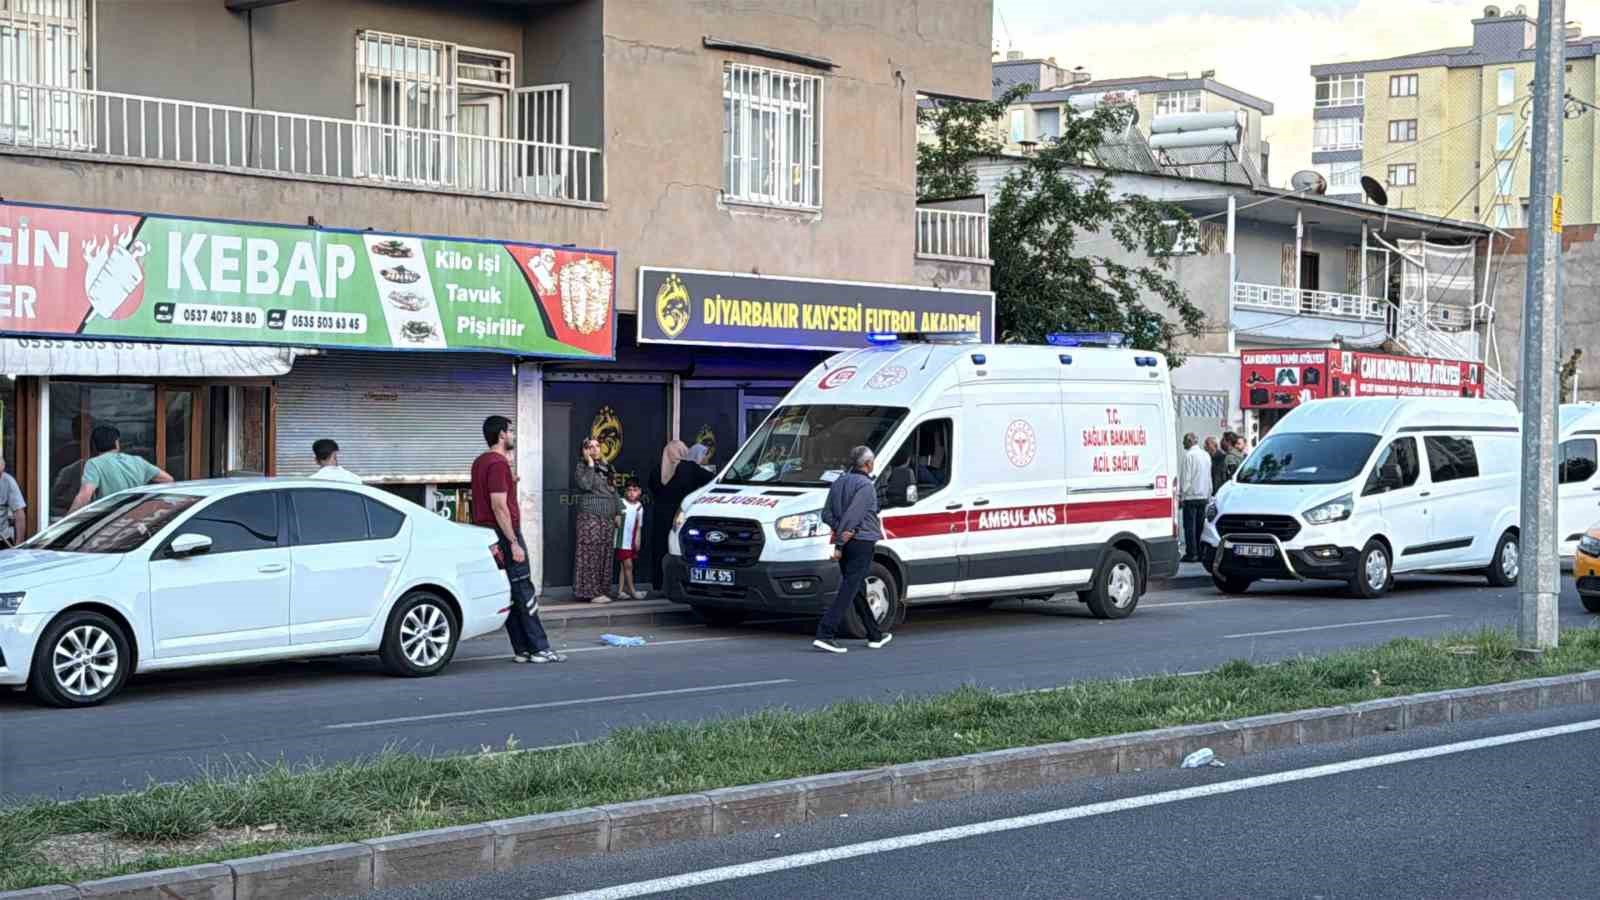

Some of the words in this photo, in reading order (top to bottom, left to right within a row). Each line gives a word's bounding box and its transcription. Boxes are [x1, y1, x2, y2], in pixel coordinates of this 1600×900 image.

[167, 231, 356, 299] KEBAP
[434, 250, 472, 271] Kilo
[445, 283, 502, 304] Tavuk
[183, 308, 208, 322] 0537
[210, 309, 228, 323] 407
[230, 311, 243, 324] 38
[244, 312, 257, 325] 80
[291, 314, 314, 328] 0535
[316, 316, 334, 329] 503
[335, 317, 347, 330] 63
[348, 317, 360, 330] 45
[703, 293, 799, 329] DİYARBAKIR
[802, 302, 862, 332] KAYSERİ
[865, 308, 915, 333] FUTBOL
[920, 311, 981, 334] AKADEMİ
[457, 315, 525, 339] Pişirilir
[1105, 408, 1121, 425] T.C.
[1083, 425, 1109, 447] SAĞLIK
[1110, 424, 1147, 447] BAKANLIĞI
[1093, 452, 1110, 472] ACİL
[1112, 450, 1140, 472] SAĞLIK
[978, 508, 1057, 530] AMBULANS
